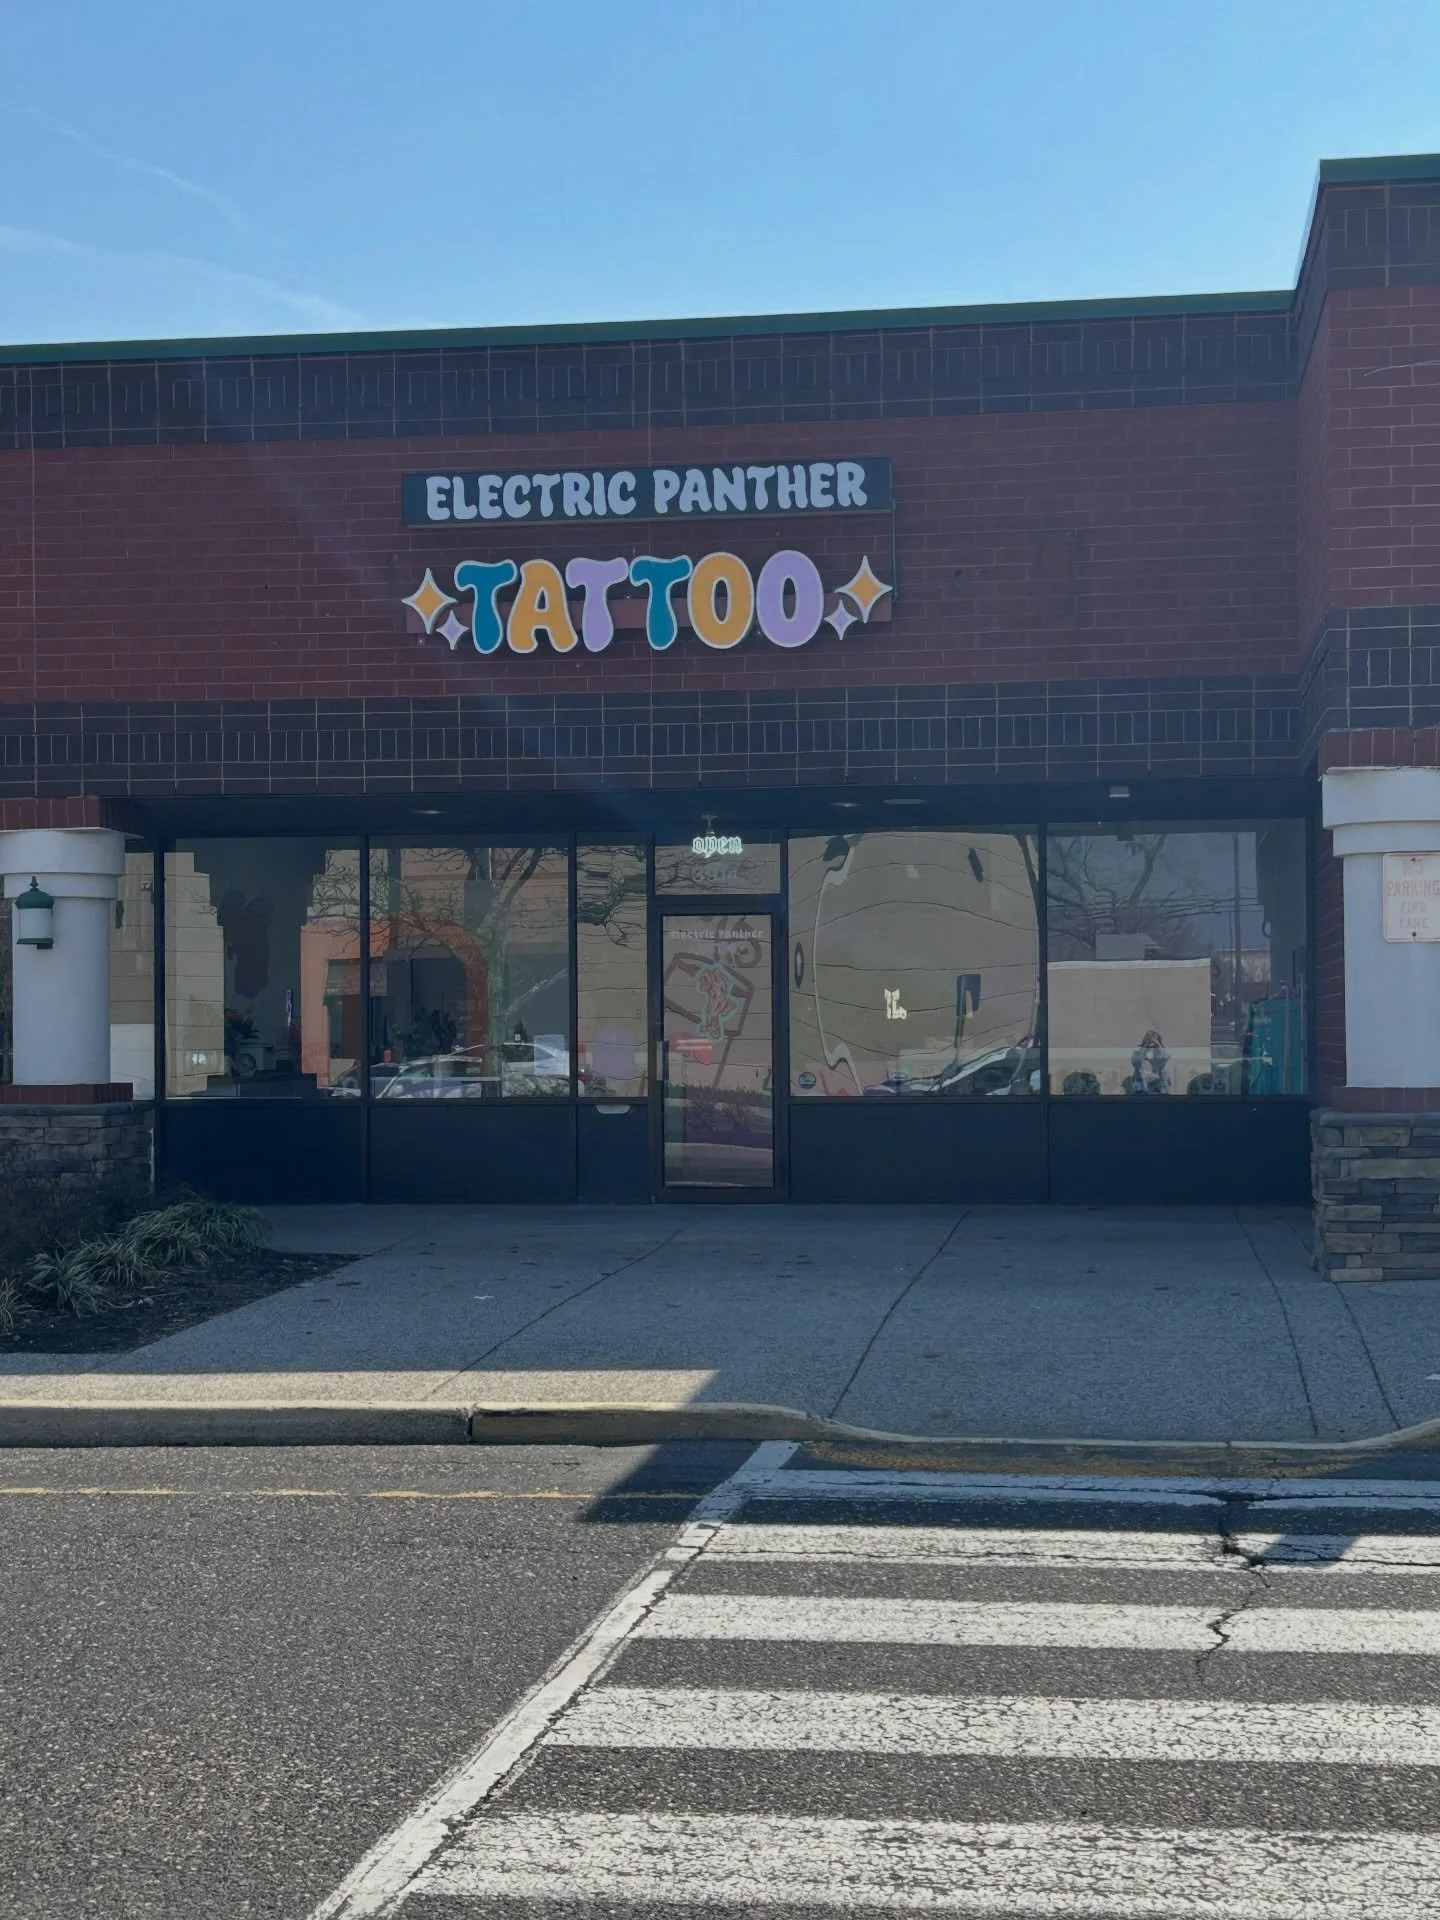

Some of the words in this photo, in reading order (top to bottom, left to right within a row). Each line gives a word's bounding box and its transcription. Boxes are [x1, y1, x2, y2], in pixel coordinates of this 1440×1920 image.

[425, 471, 637, 520] ELECTRIC
[653, 461, 868, 513] PANTHER
[454, 550, 824, 653] TATTOO
[692, 836, 743, 858] open
